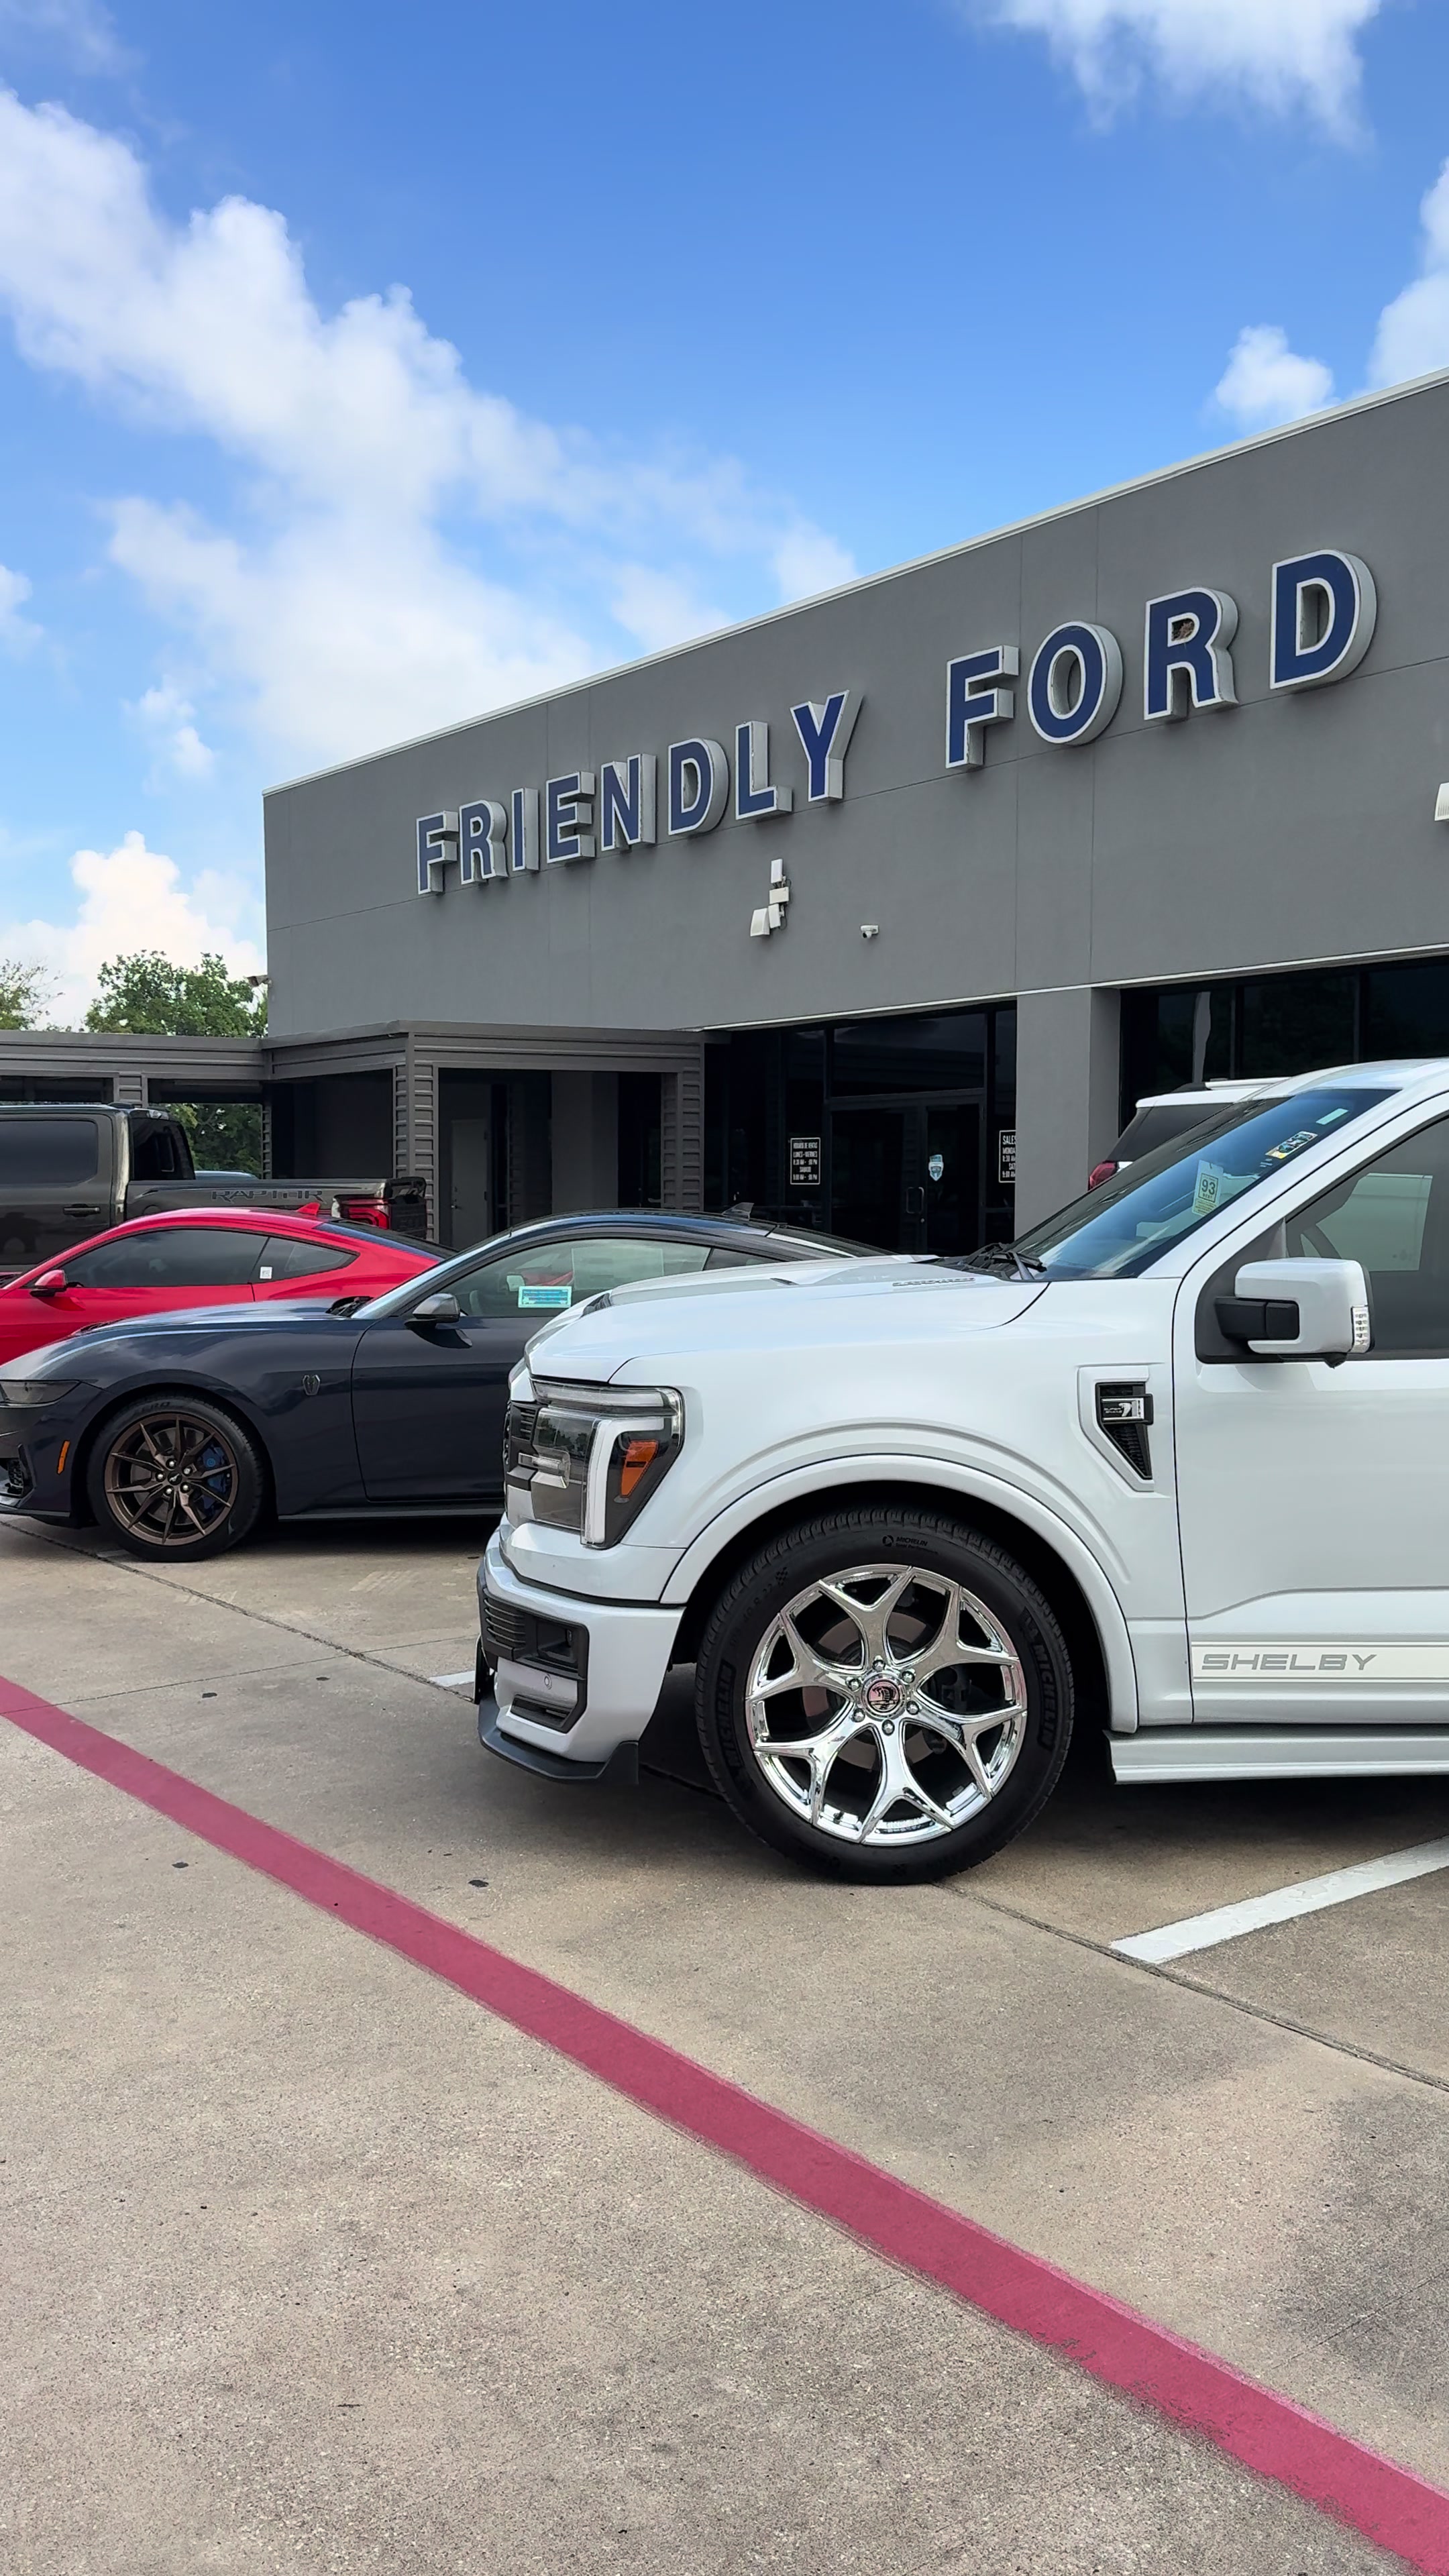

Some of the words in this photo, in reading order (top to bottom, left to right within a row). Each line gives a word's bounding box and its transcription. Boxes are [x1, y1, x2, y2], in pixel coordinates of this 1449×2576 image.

[416, 690, 862, 895] FRIENDLY
[945, 549, 1377, 770] FORD
[1201, 1179, 1216, 1195] 93
[212, 1189, 327, 1204] RAPTOR
[896, 1536, 928, 1546] MICHELIN
[1201, 1654, 1377, 1670] SHELBY
[1032, 1644, 1056, 1746] MICHELIN
